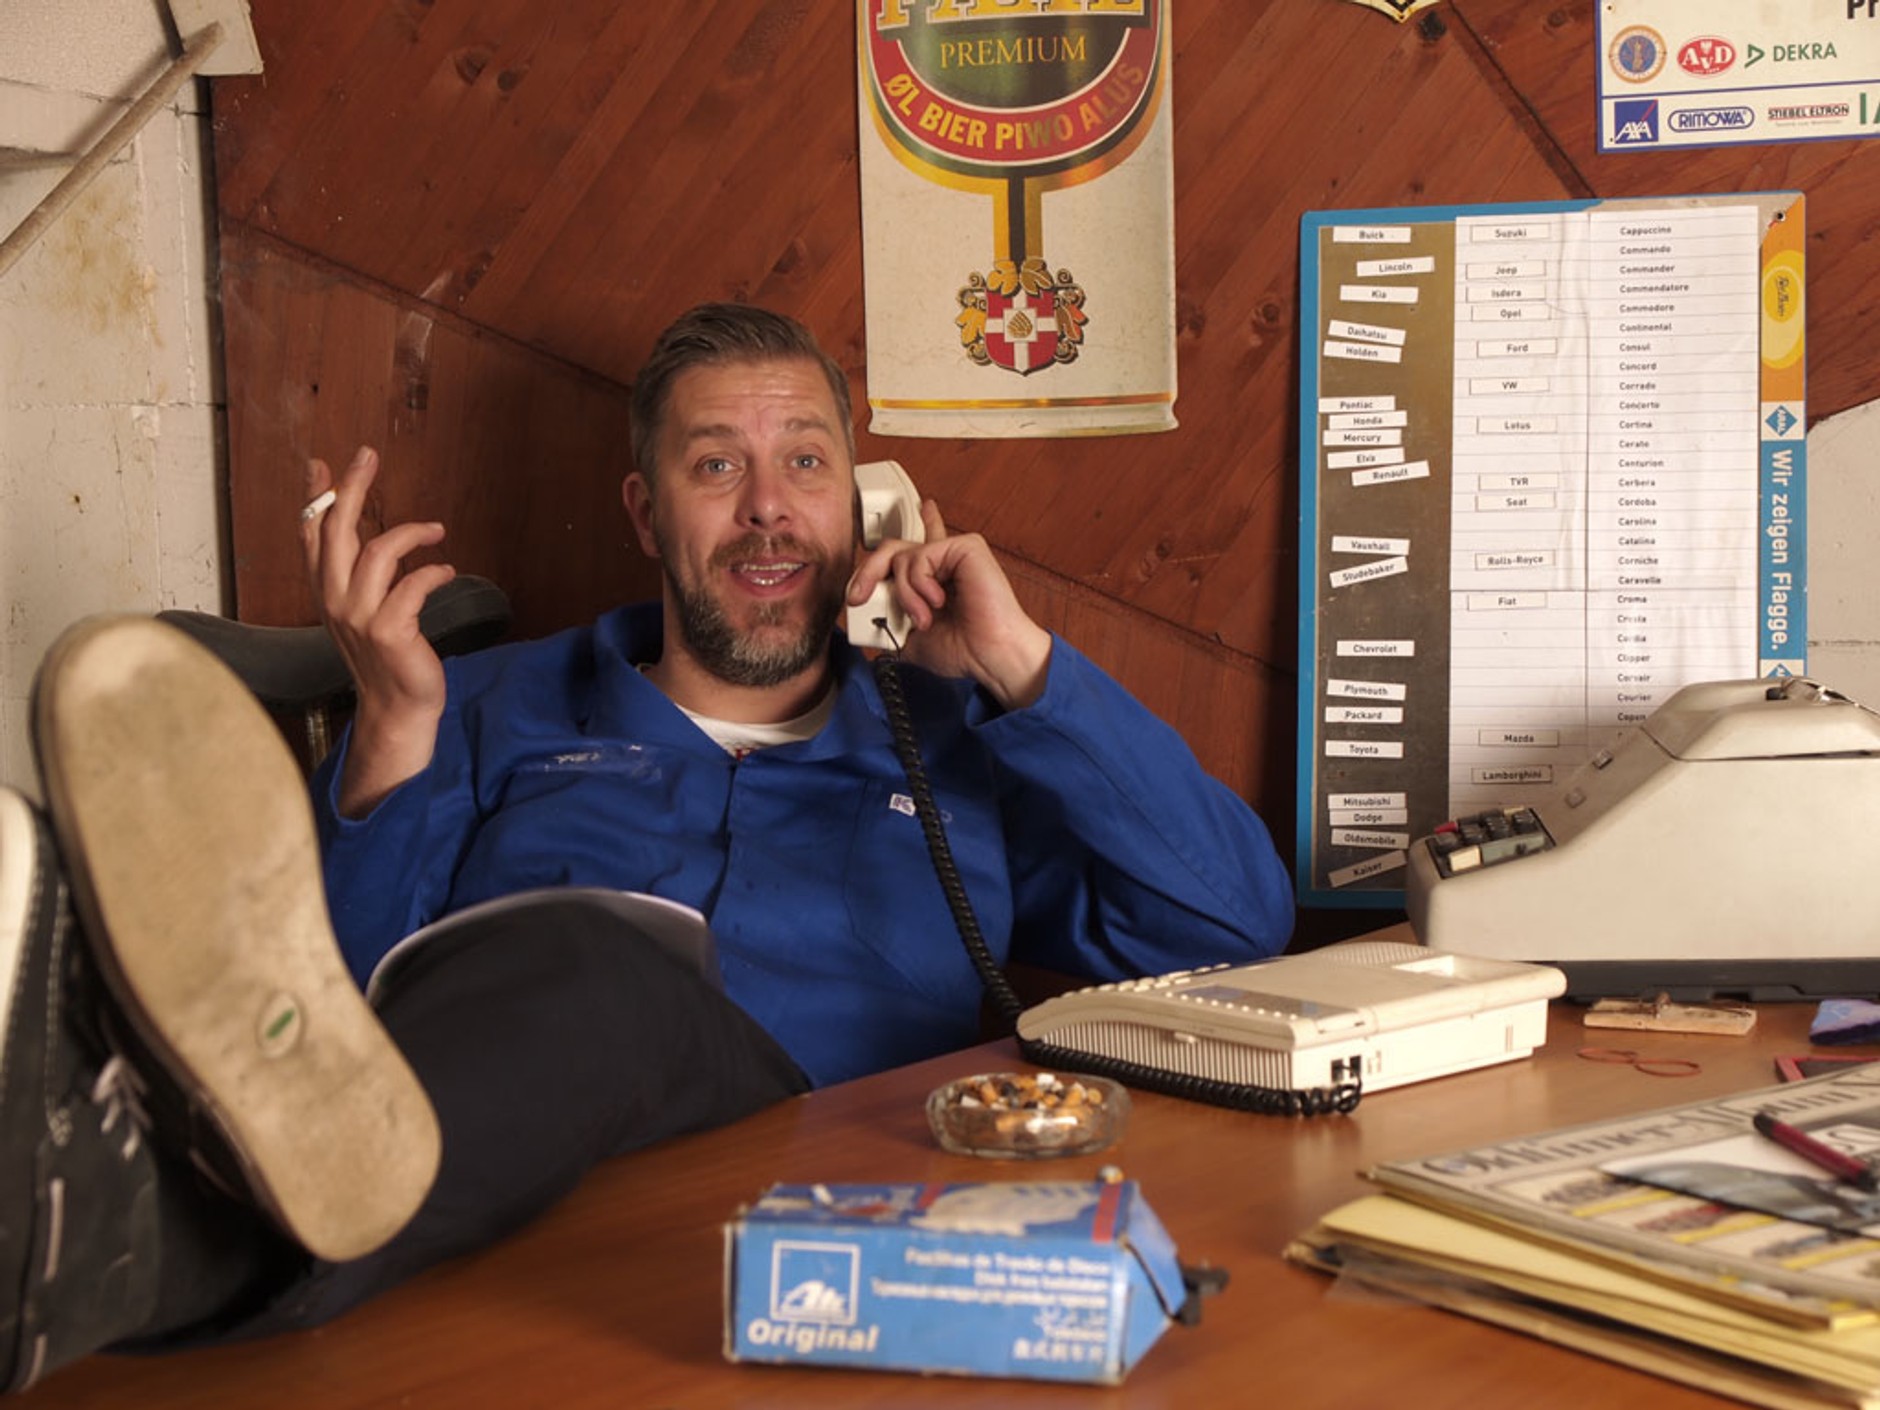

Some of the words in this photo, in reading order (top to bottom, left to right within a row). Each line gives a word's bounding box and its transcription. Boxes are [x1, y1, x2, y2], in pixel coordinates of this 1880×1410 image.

[940, 35, 1087, 69] PREMIUM
[1773, 42, 1837, 62] DEKRA
[885, 73, 913, 117] ØL
[920, 104, 988, 149] BIER
[995, 113, 1073, 151] PIWO
[1080, 62, 1144, 133] ALUS
[1768, 108, 1807, 119] STIEBEL
[1810, 105, 1849, 116] ELTRON
[1678, 111, 1746, 128] RIMOWA
[1615, 121, 1652, 140] AXA
[1359, 231, 1384, 239] Buick
[1495, 229, 1527, 237] Suzuki
[1620, 226, 1671, 236] Cappuccino
[1620, 246, 1671, 254] Commando
[1379, 263, 1412, 272] Lincoln
[1496, 267, 1517, 275] Jeep
[1620, 265, 1675, 274] Commander
[1372, 290, 1387, 298] Kia
[1620, 304, 1674, 312] Commodore
[1501, 309, 1521, 318] Opel
[1620, 323, 1672, 332] Continental
[1348, 327, 1387, 339] Daihatsu
[1507, 344, 1528, 352] Ford
[1620, 343, 1650, 351] Consul
[1346, 348, 1378, 357] Holden
[1340, 401, 1373, 409] Pontiac
[1353, 417, 1382, 425] Honda
[1620, 421, 1652, 429] Cortina
[1505, 422, 1530, 430] Lotus
[1344, 434, 1381, 442] Mercury
[1772, 448, 1793, 487] Wir
[1511, 477, 1528, 485] TVR
[1506, 498, 1527, 506] Seat
[1619, 498, 1656, 506] Cordoba
[1766, 494, 1793, 564] zeigen
[1351, 541, 1390, 550] Vauxhall
[1488, 555, 1543, 565] Rolls-Royce
[1618, 557, 1658, 565] Corniche
[1343, 563, 1394, 581] Studebaker
[1498, 597, 1516, 605] Fiat
[1767, 572, 1793, 651] Flagge.
[1354, 644, 1397, 653] Chevrolet
[1344, 685, 1388, 696] Plymouth
[1345, 711, 1382, 719] Packard
[1504, 734, 1534, 743] Mazda
[1350, 745, 1378, 755] Toyota
[1483, 771, 1541, 781] Lamborghini
[1344, 797, 1391, 806] Mitsubishi
[1354, 814, 1382, 822] Dodge
[1344, 834, 1396, 844] Oldsmobile
[747, 1318, 879, 1354] Original
